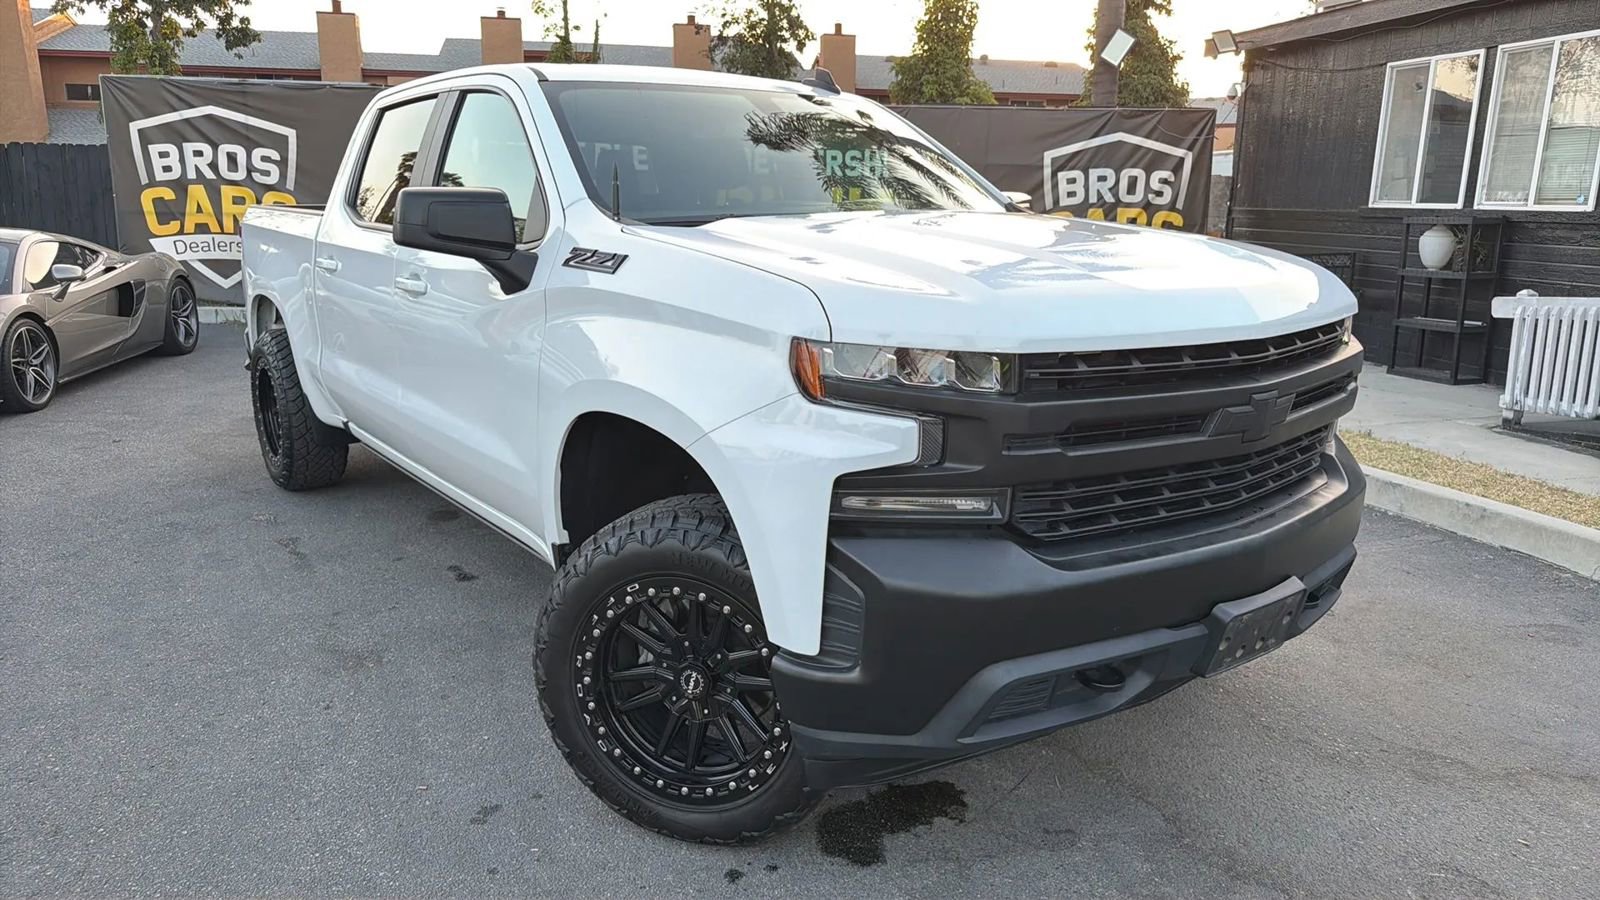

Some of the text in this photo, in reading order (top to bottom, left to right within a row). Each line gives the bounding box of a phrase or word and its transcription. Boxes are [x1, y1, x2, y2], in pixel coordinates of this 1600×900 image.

[148, 142, 281, 185] BROS
[1057, 167, 1175, 207] BROS
[140, 185, 298, 236] CAR
[562, 247, 629, 274] Z71
